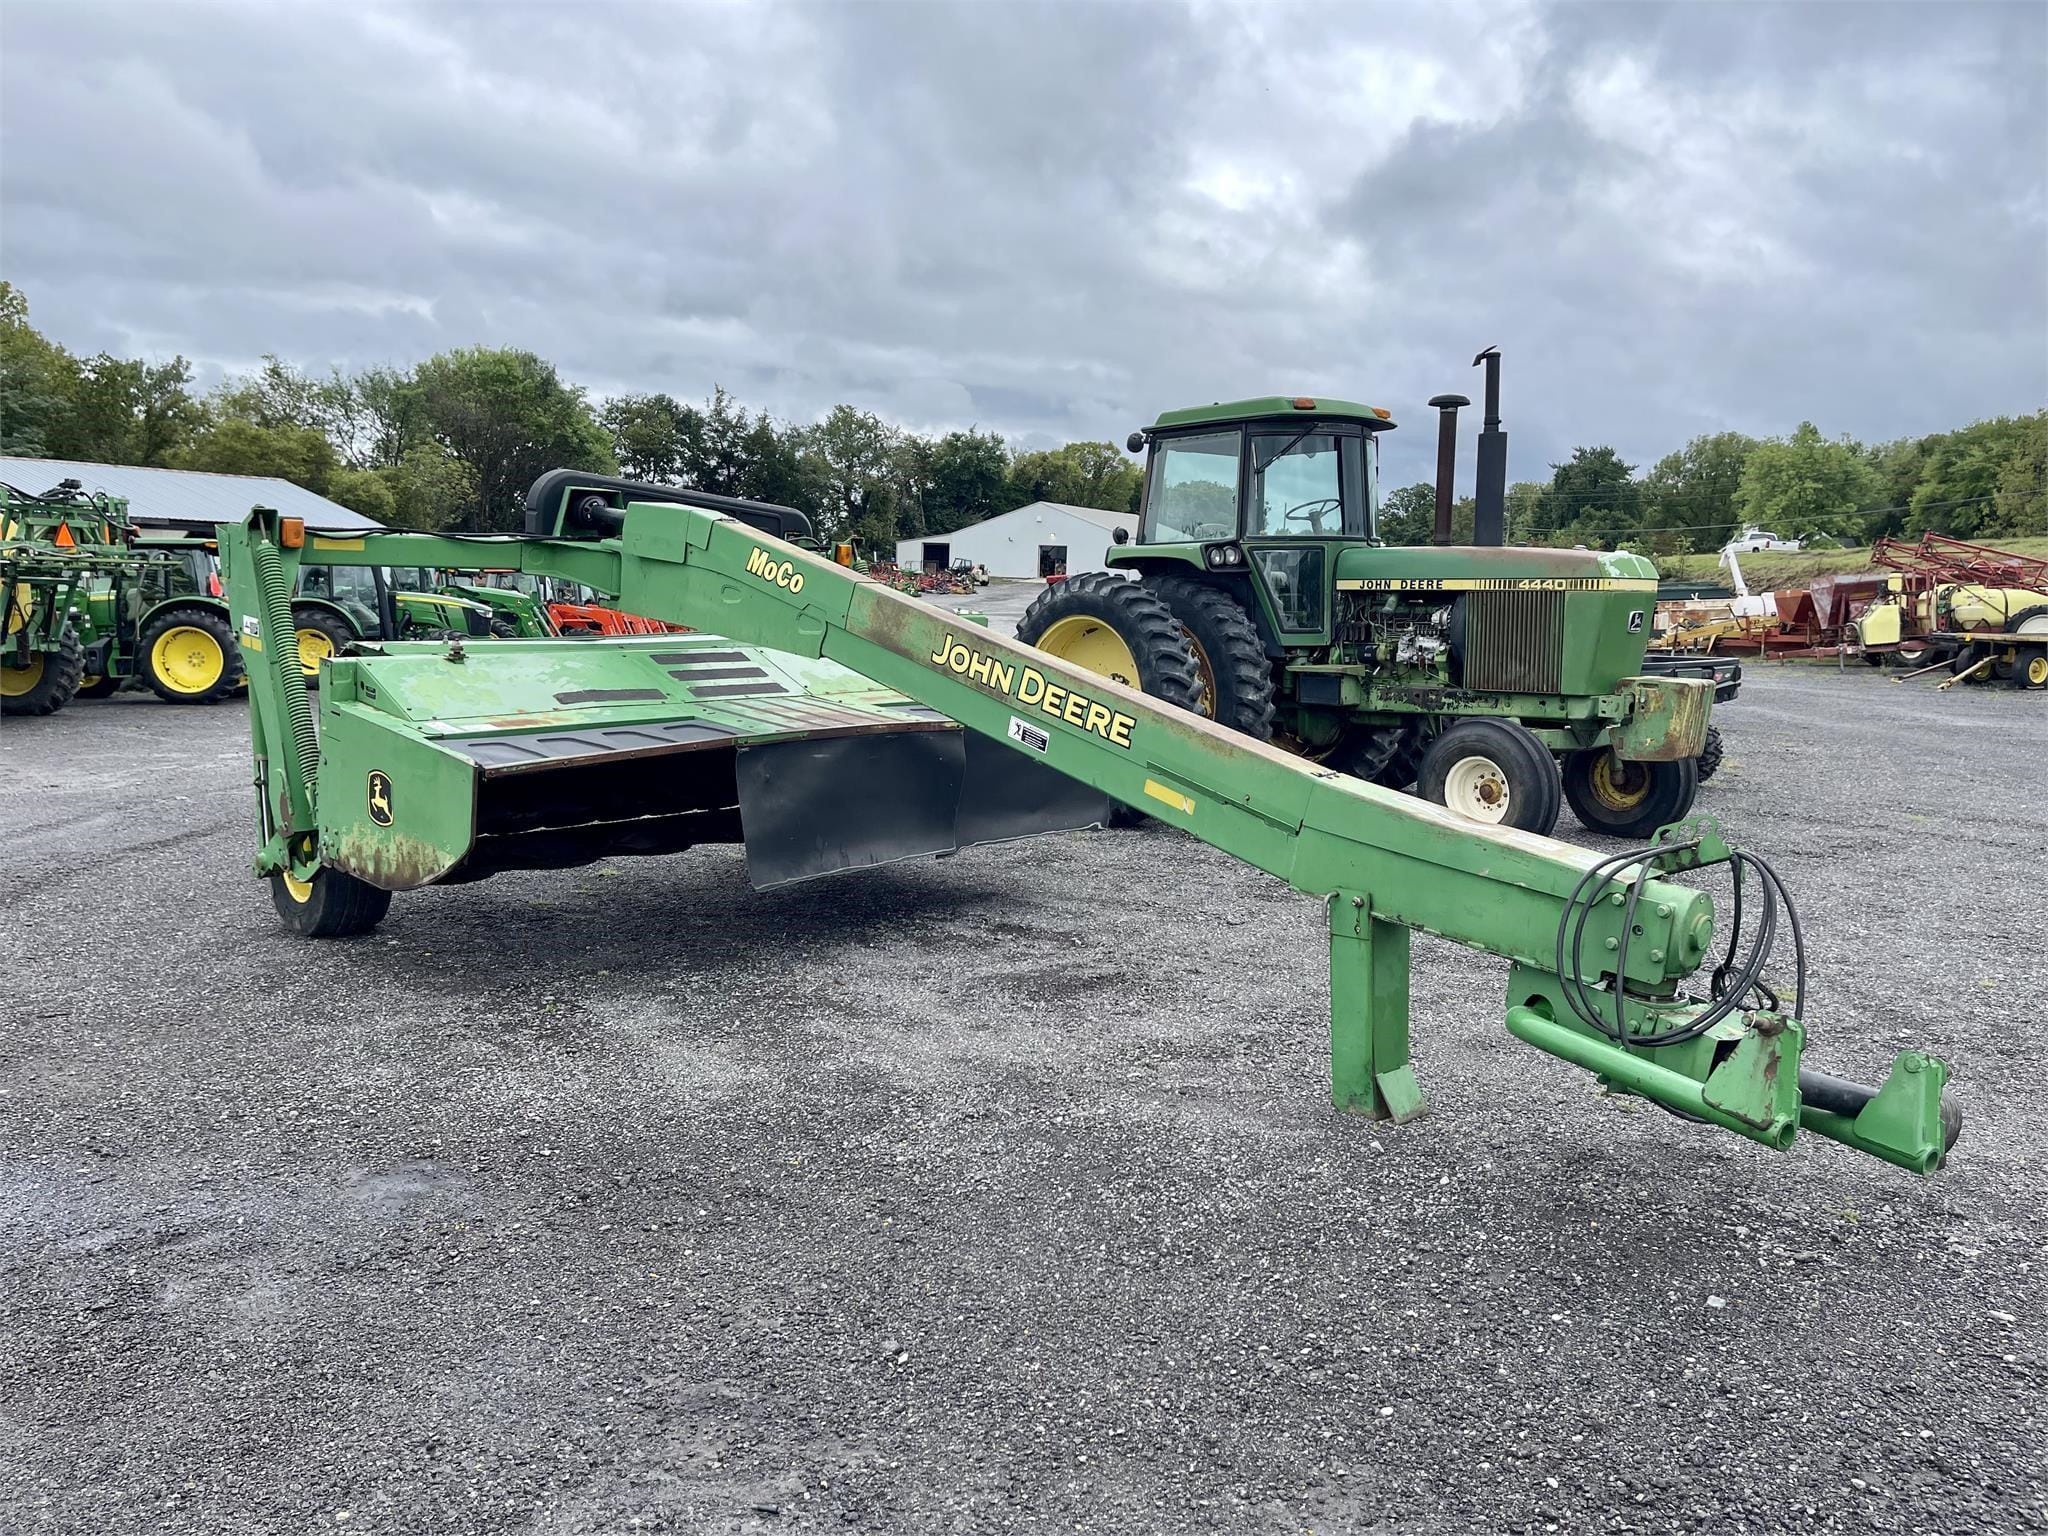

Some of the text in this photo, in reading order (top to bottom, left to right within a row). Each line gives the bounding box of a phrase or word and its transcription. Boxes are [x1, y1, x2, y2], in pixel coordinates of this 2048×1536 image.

[745, 546, 805, 594] MoCo
[1518, 579, 1567, 590] 4440
[1359, 580, 1443, 590] JOHN DEERE
[931, 633, 1137, 749] JOHN DEERE
